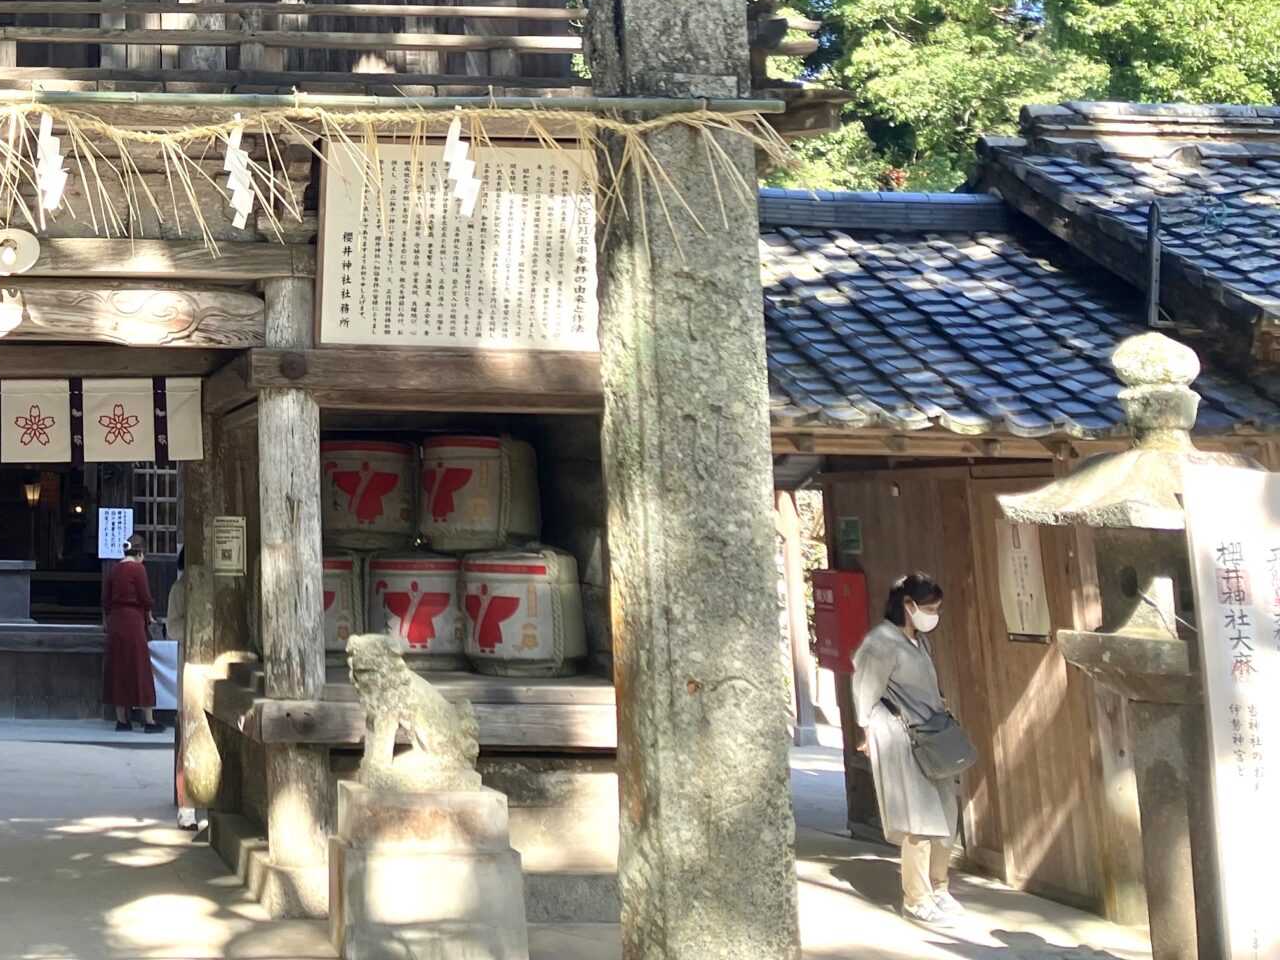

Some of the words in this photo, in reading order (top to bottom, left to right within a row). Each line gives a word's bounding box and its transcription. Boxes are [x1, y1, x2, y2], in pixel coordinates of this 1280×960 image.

[339, 230, 355, 329] 櫻井神社社務所
[1215, 540, 1257, 677] 櫻井神社大麻
[1228, 703, 1246, 777] 伊勢神宮と
